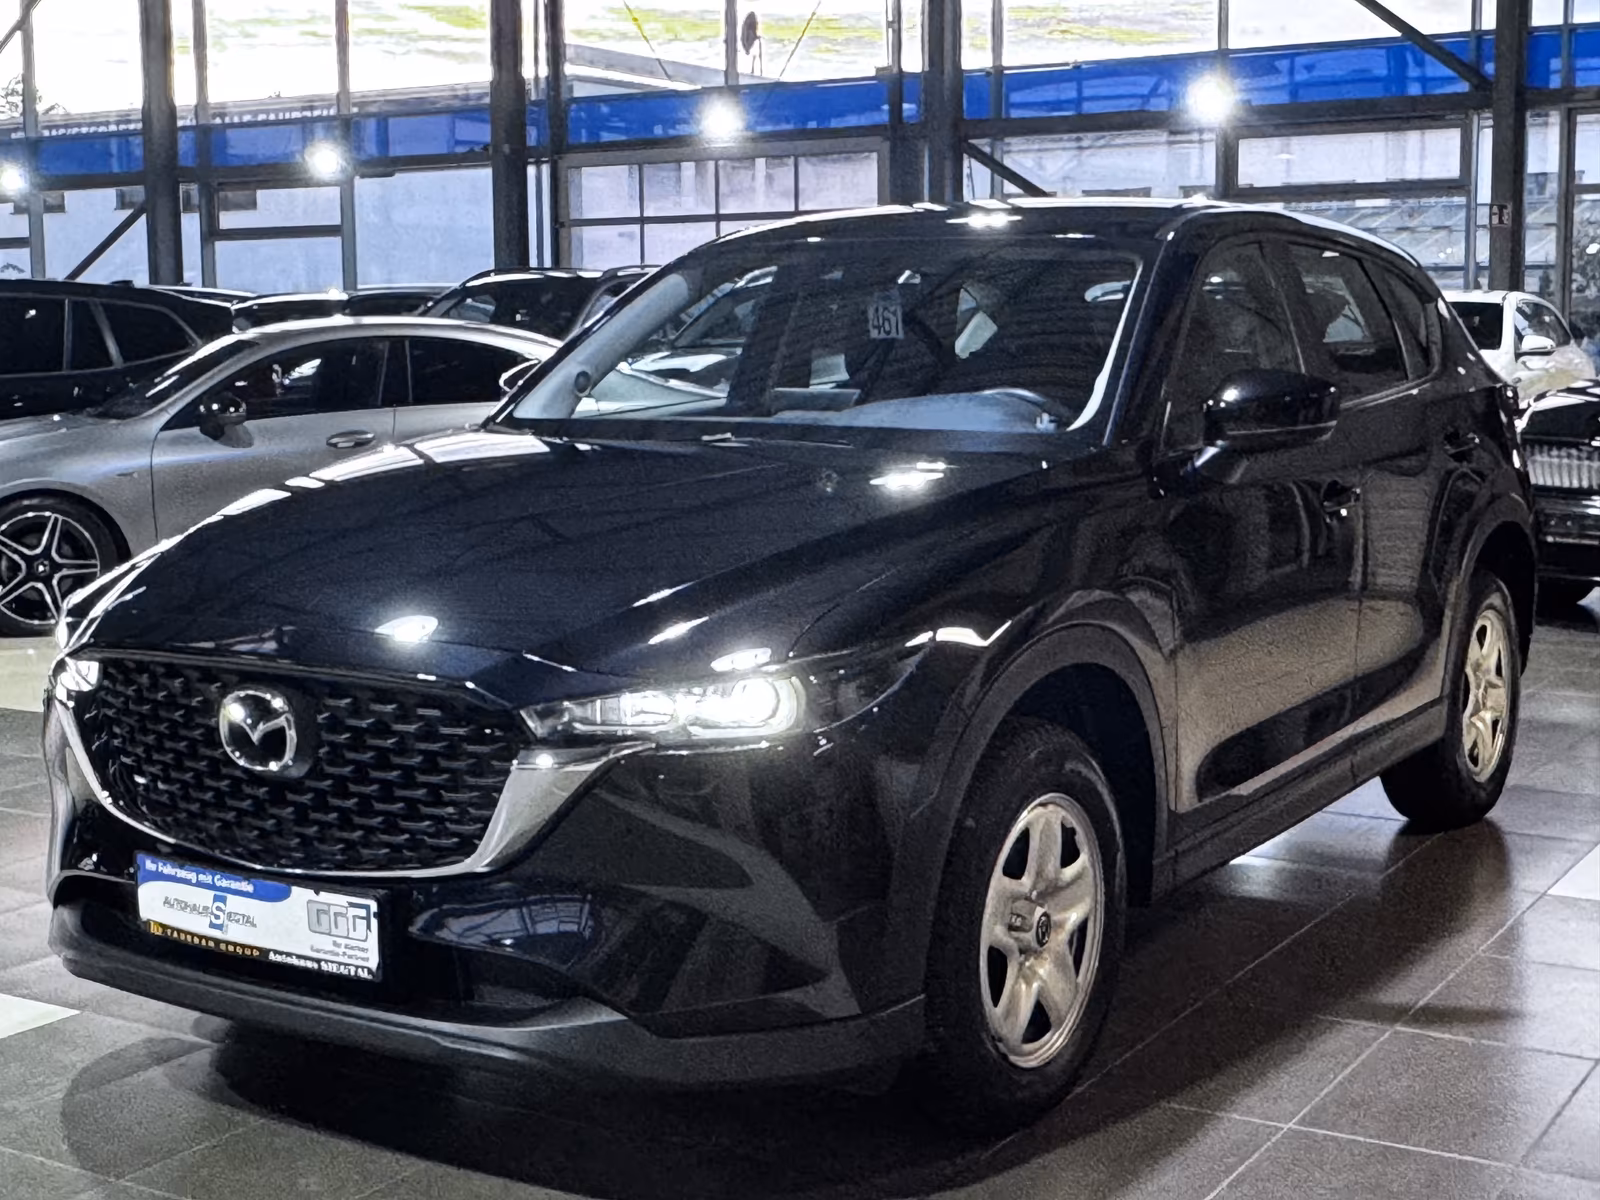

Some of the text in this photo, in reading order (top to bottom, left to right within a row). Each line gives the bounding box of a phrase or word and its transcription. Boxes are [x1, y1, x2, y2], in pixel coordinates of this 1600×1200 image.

[872, 306, 899, 336] 461
[158, 861, 197, 884] Fahrzeug
[214, 874, 254, 893] Garantie
[268, 950, 319, 970] Autohaus
